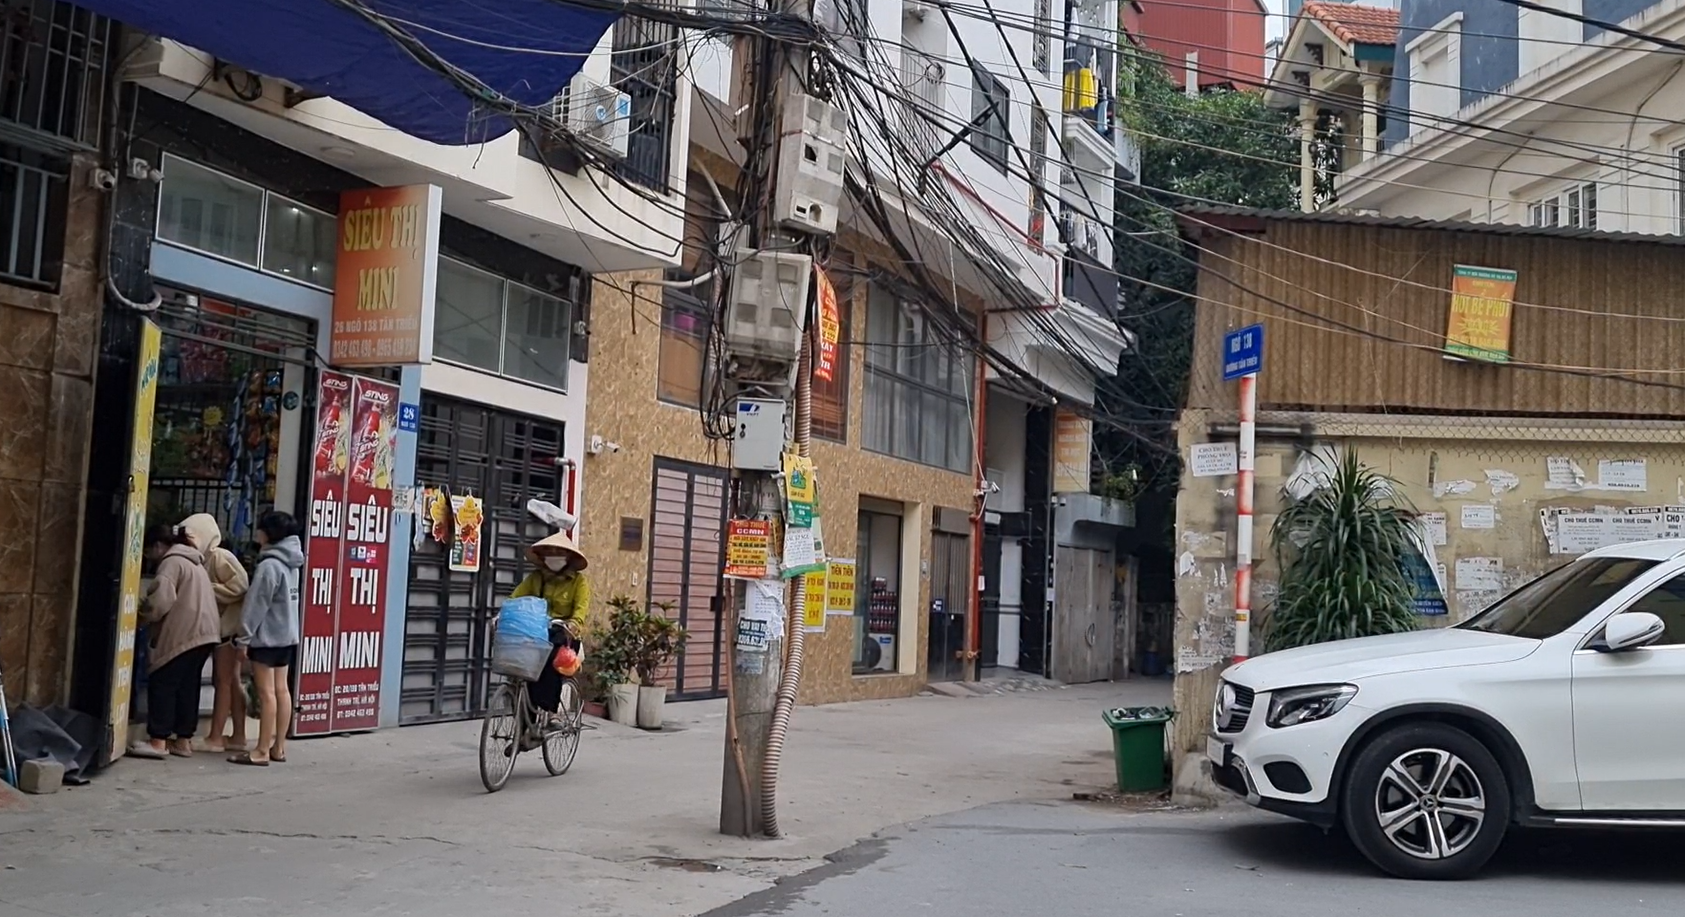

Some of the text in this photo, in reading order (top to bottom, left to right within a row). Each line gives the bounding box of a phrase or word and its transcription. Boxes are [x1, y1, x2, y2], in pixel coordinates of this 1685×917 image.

[343, 196, 421, 260] SIÊU THỊ
[357, 266, 399, 311] MINI
[1472, 289, 1485, 315] BỂ
[363, 319, 377, 331] 138
[324, 379, 348, 388] STING
[363, 390, 389, 401] STING
[403, 406, 415, 420] 28
[311, 489, 342, 538] SIÊU
[347, 494, 388, 543] SIÊU
[1666, 514, 1680, 522] CHO
[312, 568, 333, 614] THỊ
[350, 567, 378, 614] THỊ
[302, 636, 332, 673] MINI
[339, 631, 380, 669] MINI
